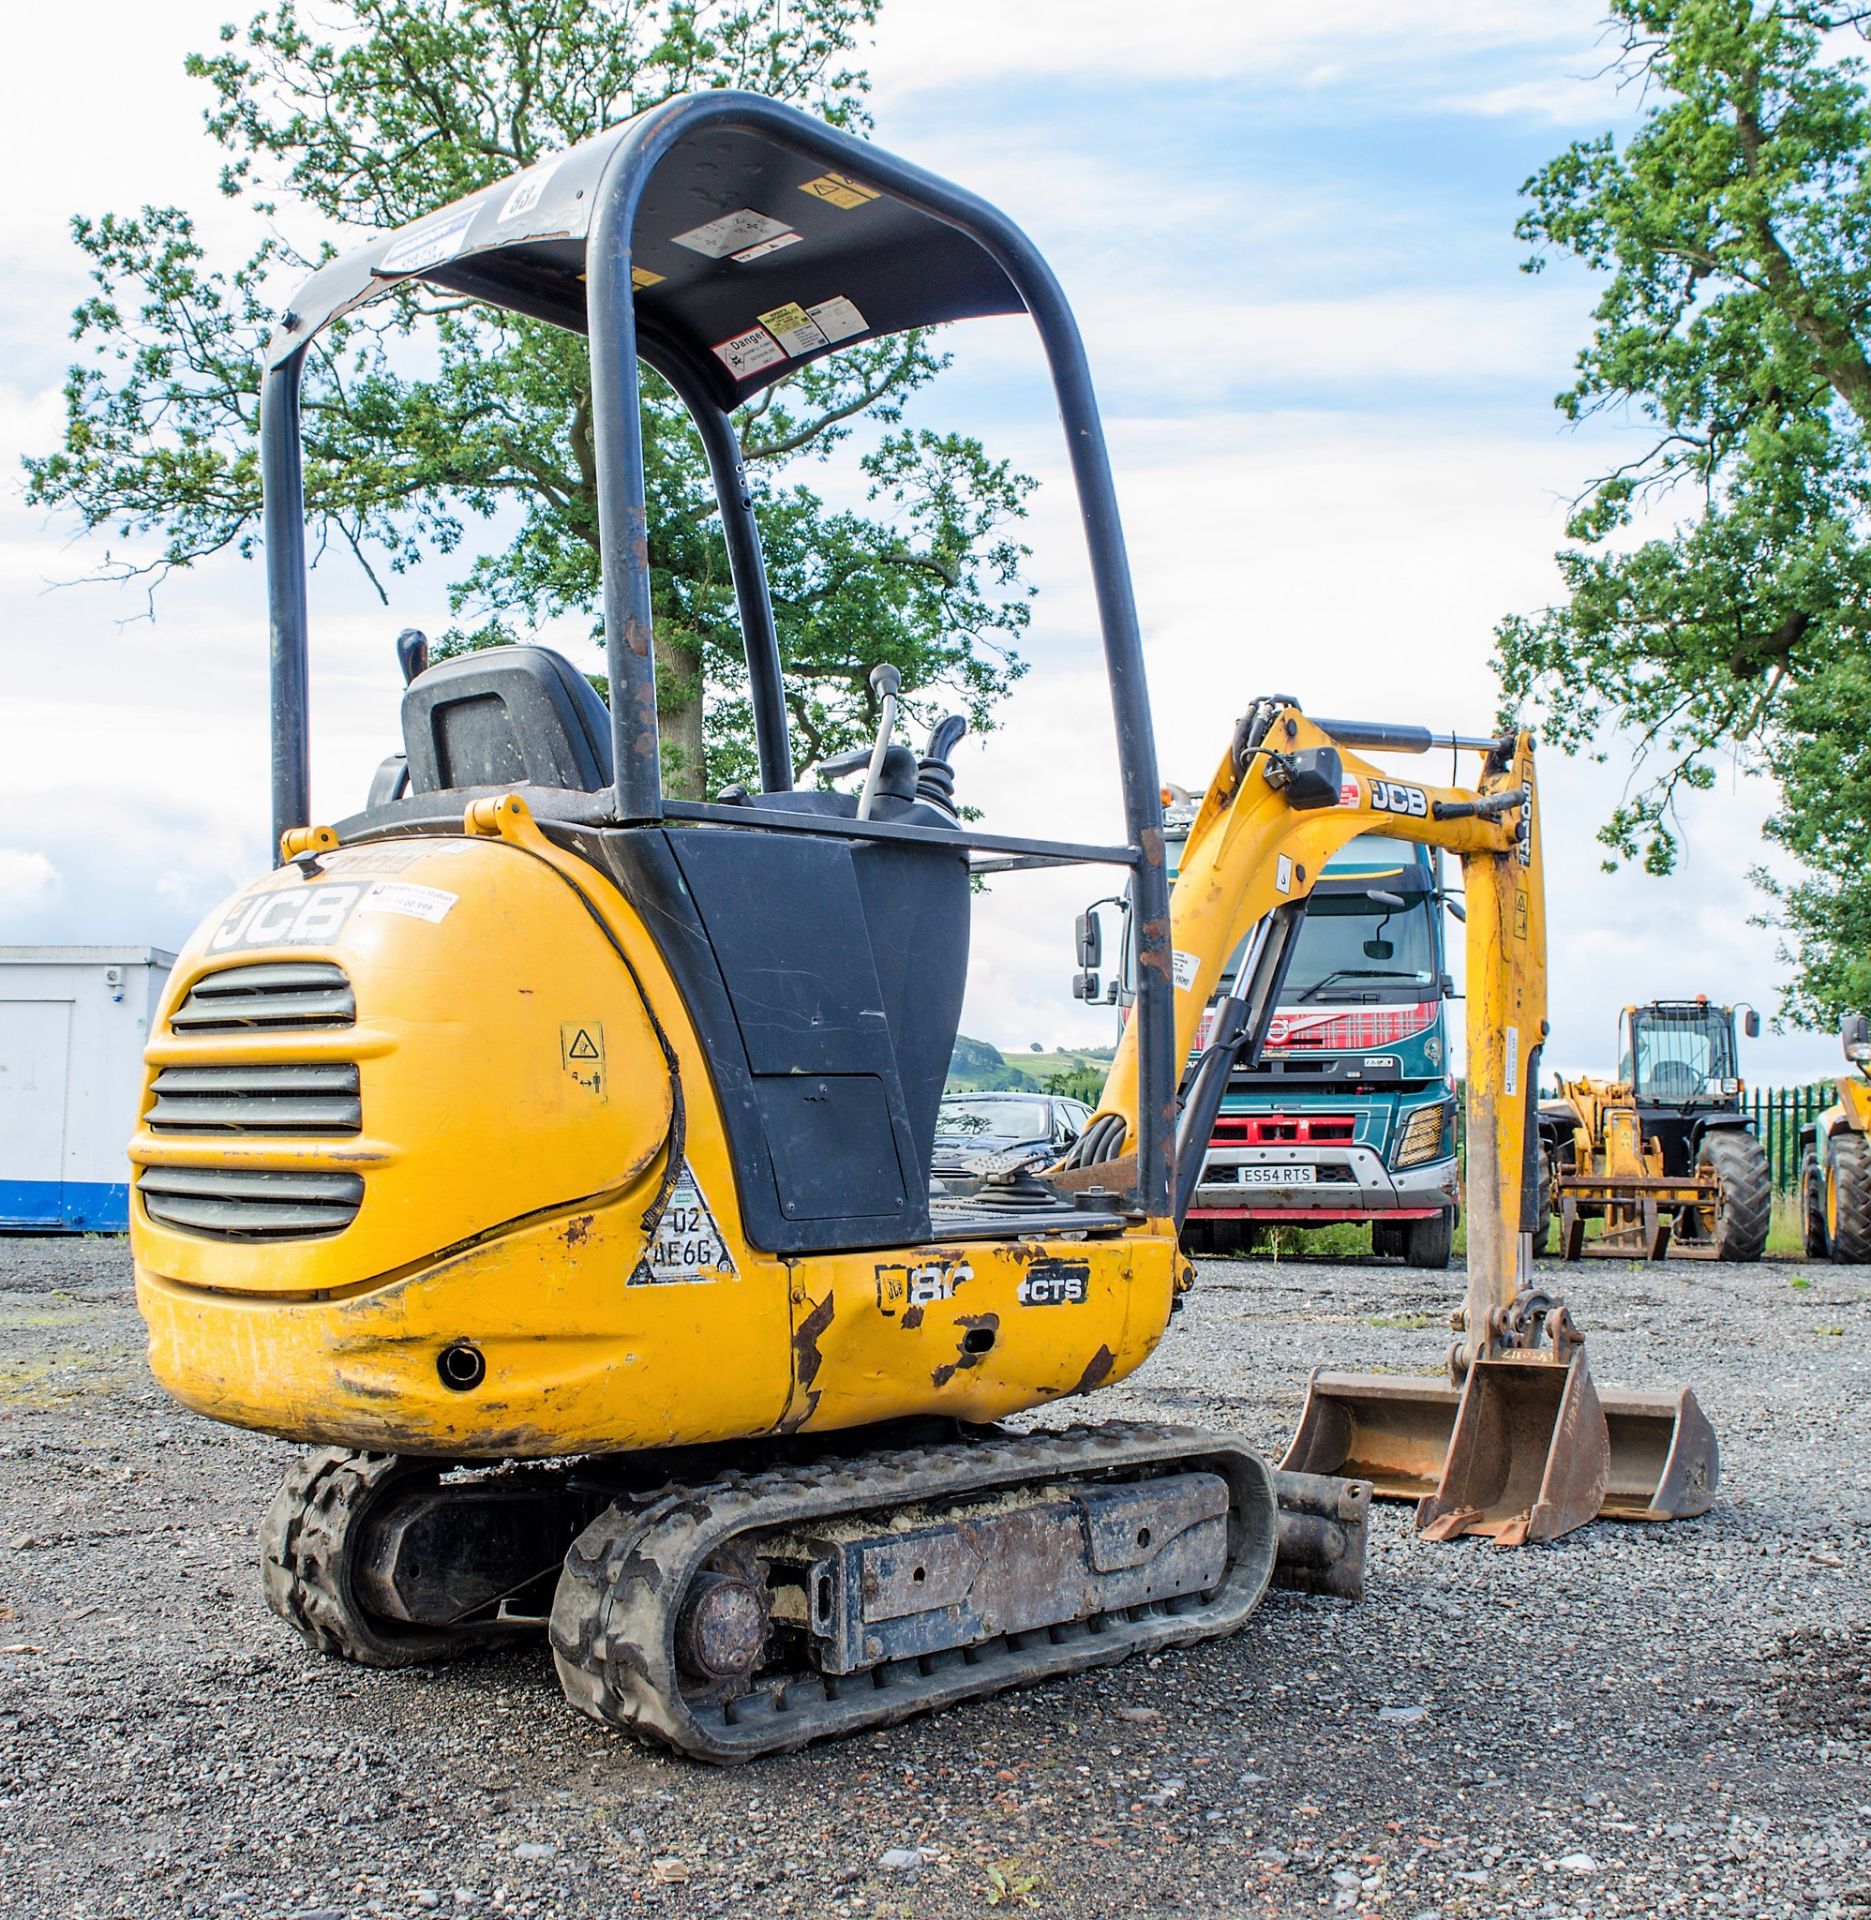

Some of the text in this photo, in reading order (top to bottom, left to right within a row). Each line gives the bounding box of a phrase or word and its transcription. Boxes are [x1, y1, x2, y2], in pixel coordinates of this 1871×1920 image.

[730, 331, 766, 351] Danger
[1372, 782, 1427, 816] JCB
[212, 886, 360, 949] JCB
[1244, 1168, 1310, 1182] ES54 RTS
[1030, 1278, 1082, 1301] CTS
